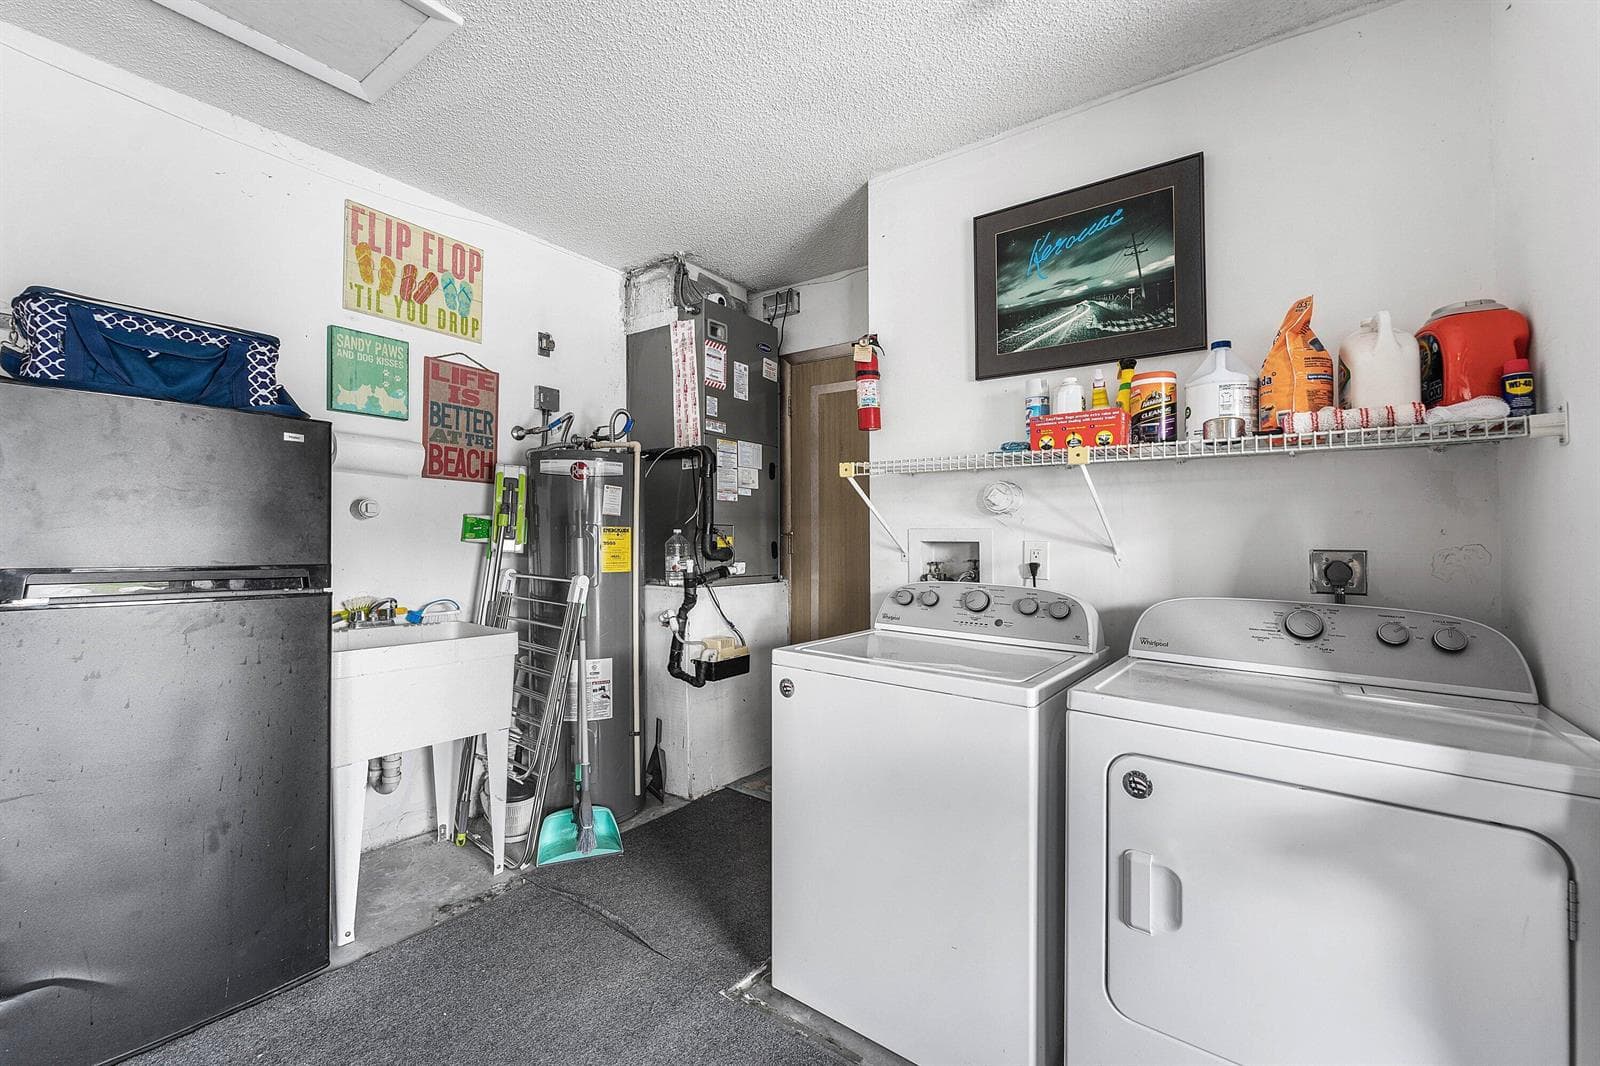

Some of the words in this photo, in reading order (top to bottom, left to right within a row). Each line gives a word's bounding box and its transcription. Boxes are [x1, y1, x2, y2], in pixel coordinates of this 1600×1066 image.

[351, 204, 412, 260] FLIP
[422, 231, 481, 284] FLOP
[394, 294, 428, 326] YOU
[437, 307, 480, 339] DROP
[336, 333, 372, 354] SANDY
[375, 341, 404, 360] PAWS
[336, 348, 354, 360] AND
[357, 352, 374, 364] DOG
[376, 356, 405, 369] KISSES
[431, 362, 495, 393] LIFE
[1507, 379, 1532, 388] WD-40
[448, 384, 480, 407] IS
[430, 400, 494, 436] BETTER
[429, 428, 462, 446] AT
[465, 432, 494, 450] THE
[429, 443, 494, 480] BEACH
[1139, 639, 1169, 648] Whirlpool
